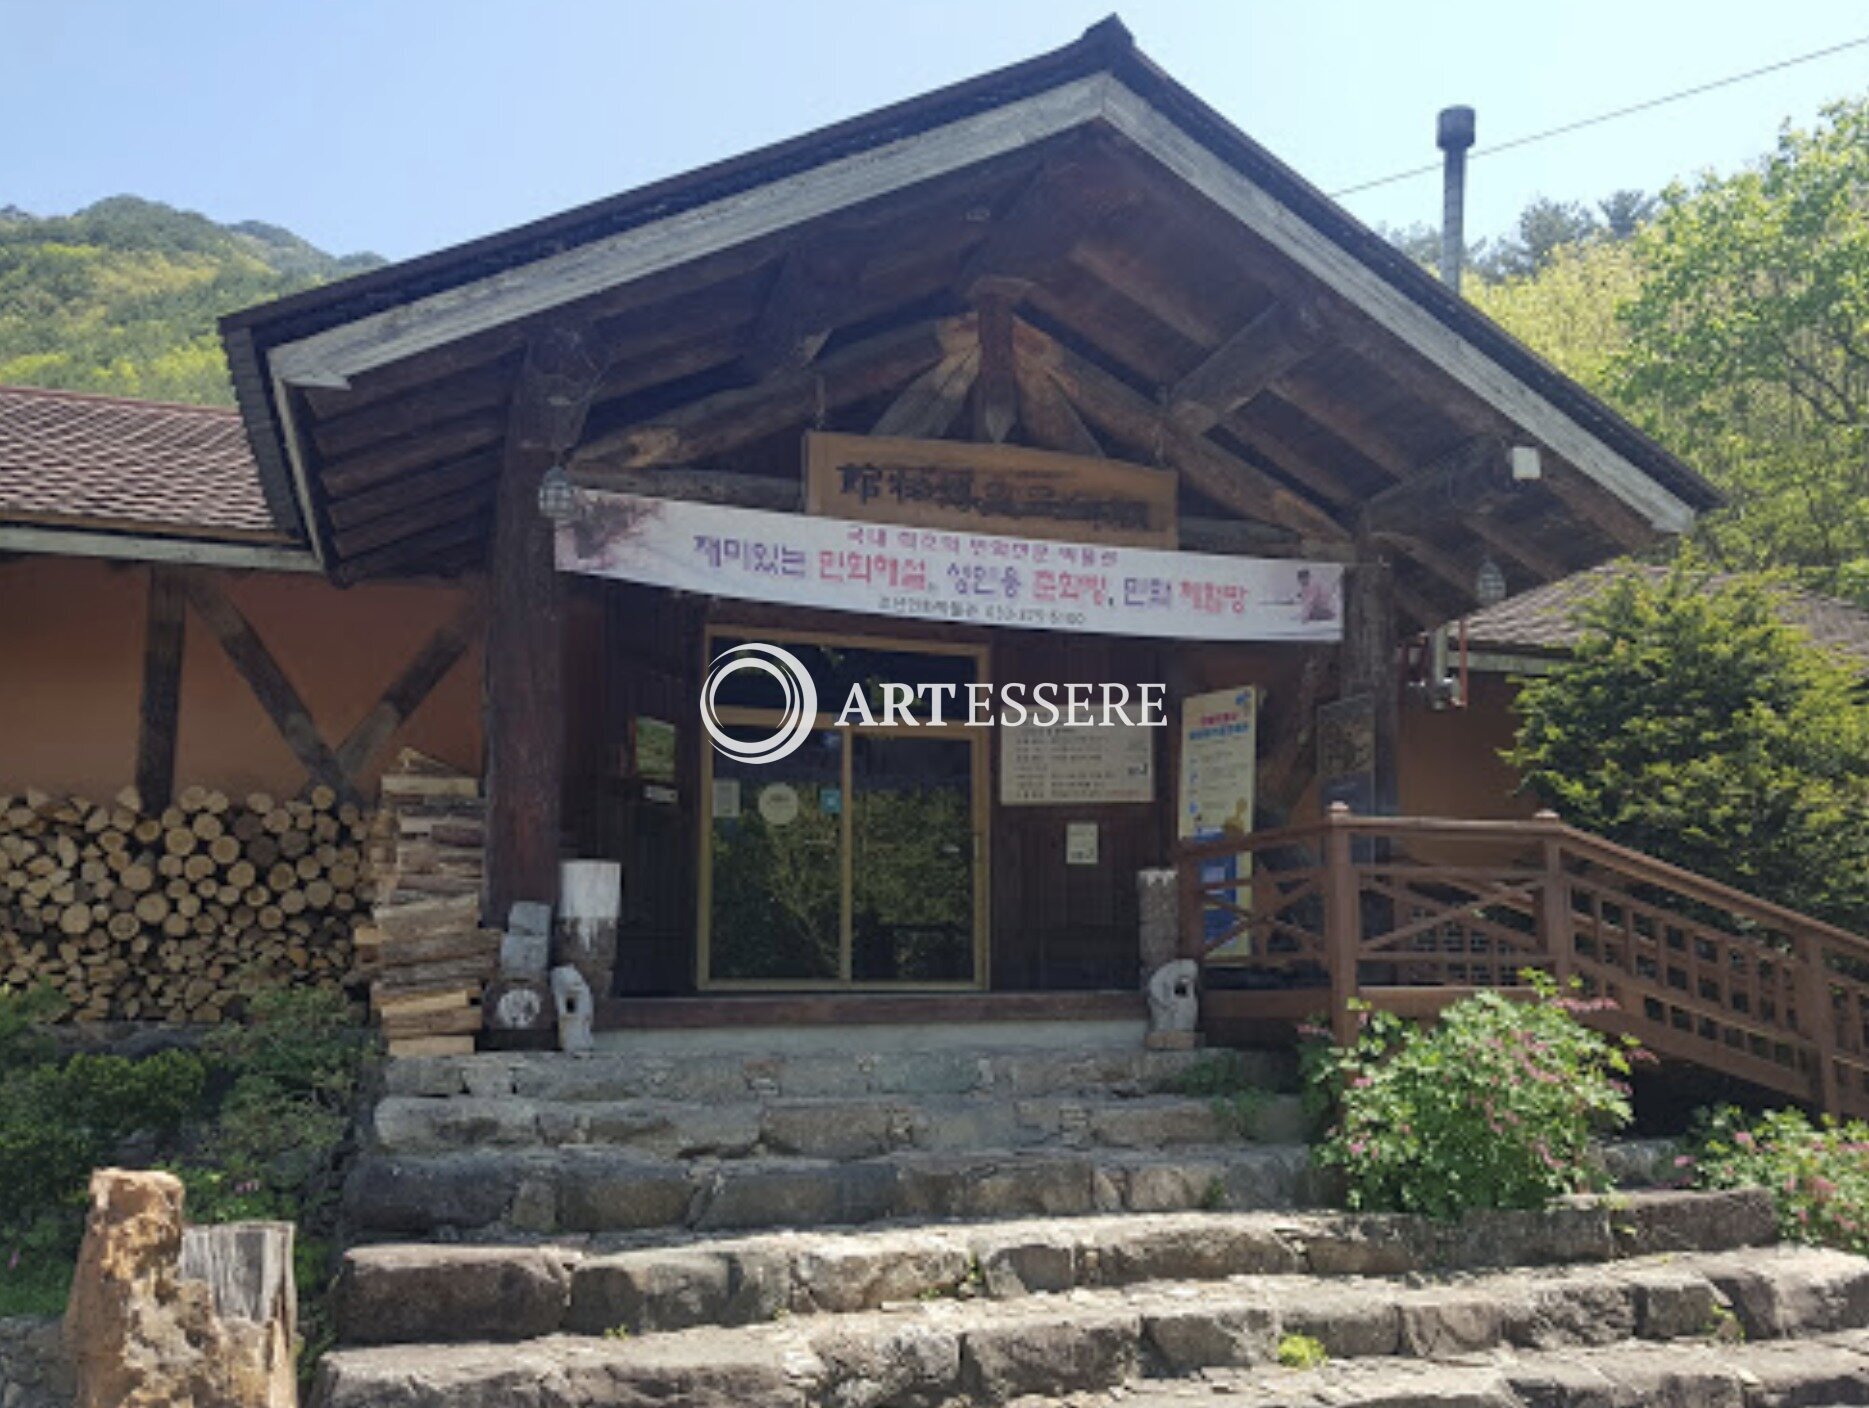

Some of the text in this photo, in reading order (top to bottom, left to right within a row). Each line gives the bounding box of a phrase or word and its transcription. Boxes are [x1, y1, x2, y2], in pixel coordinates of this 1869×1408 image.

[693, 535, 804, 577] 재미있는
[947, 562, 1021, 598] 성인용
[1124, 577, 1171, 608] 민화
